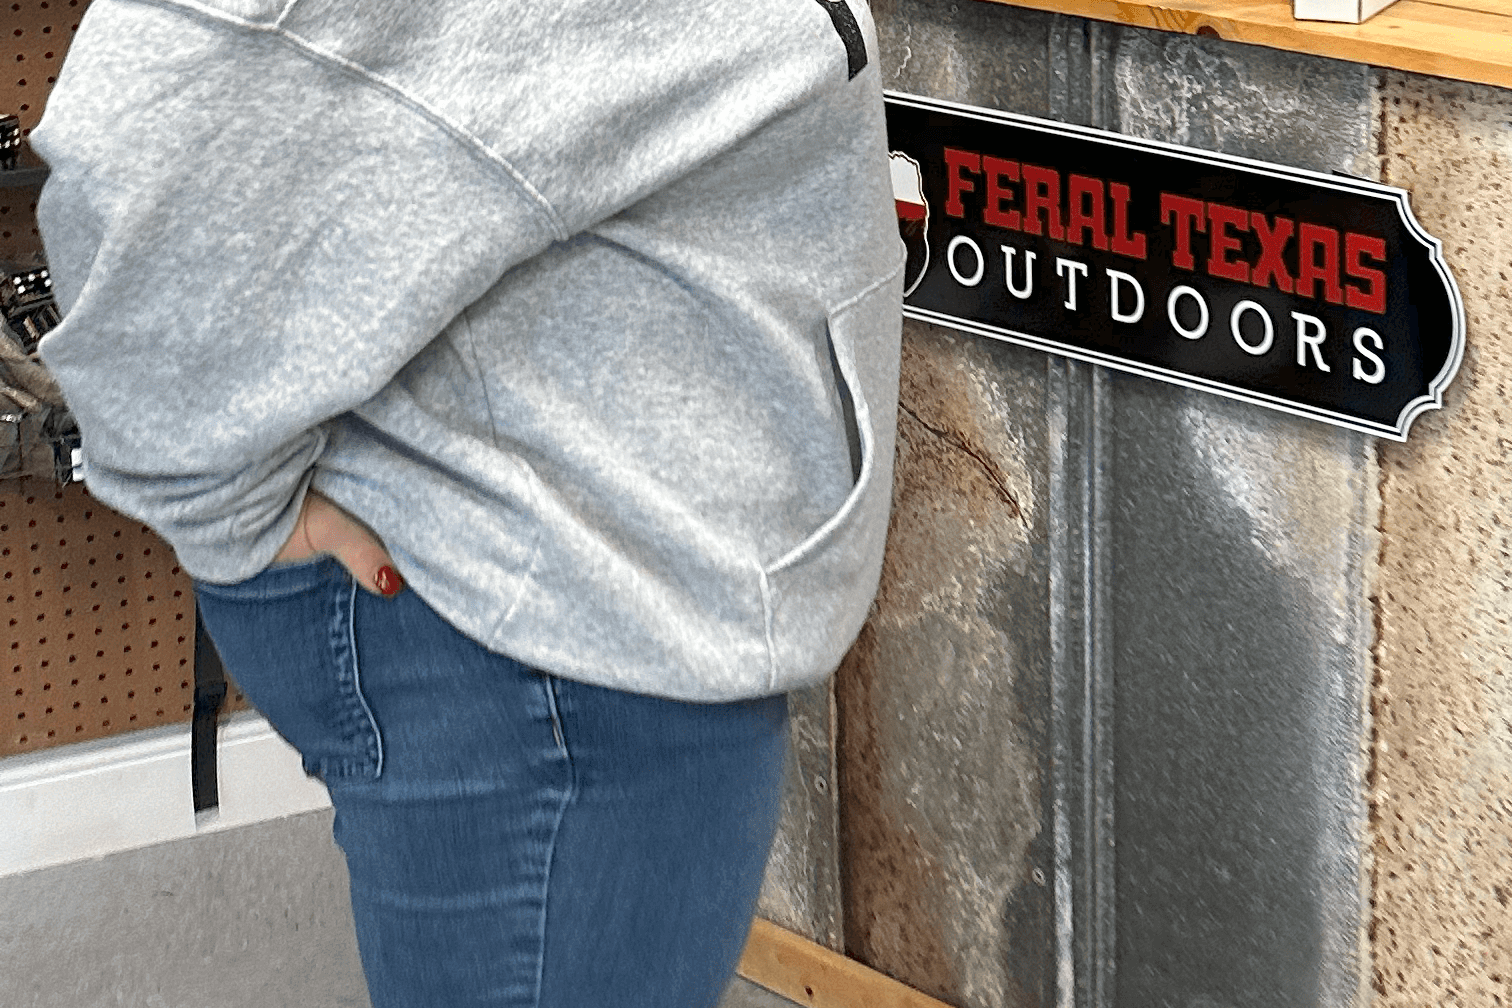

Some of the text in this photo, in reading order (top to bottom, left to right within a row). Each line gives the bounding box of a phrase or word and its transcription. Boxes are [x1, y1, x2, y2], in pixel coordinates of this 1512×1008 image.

[943, 146, 1388, 316] FERAL TEXAS
[945, 234, 1387, 385] OUTDOORS
